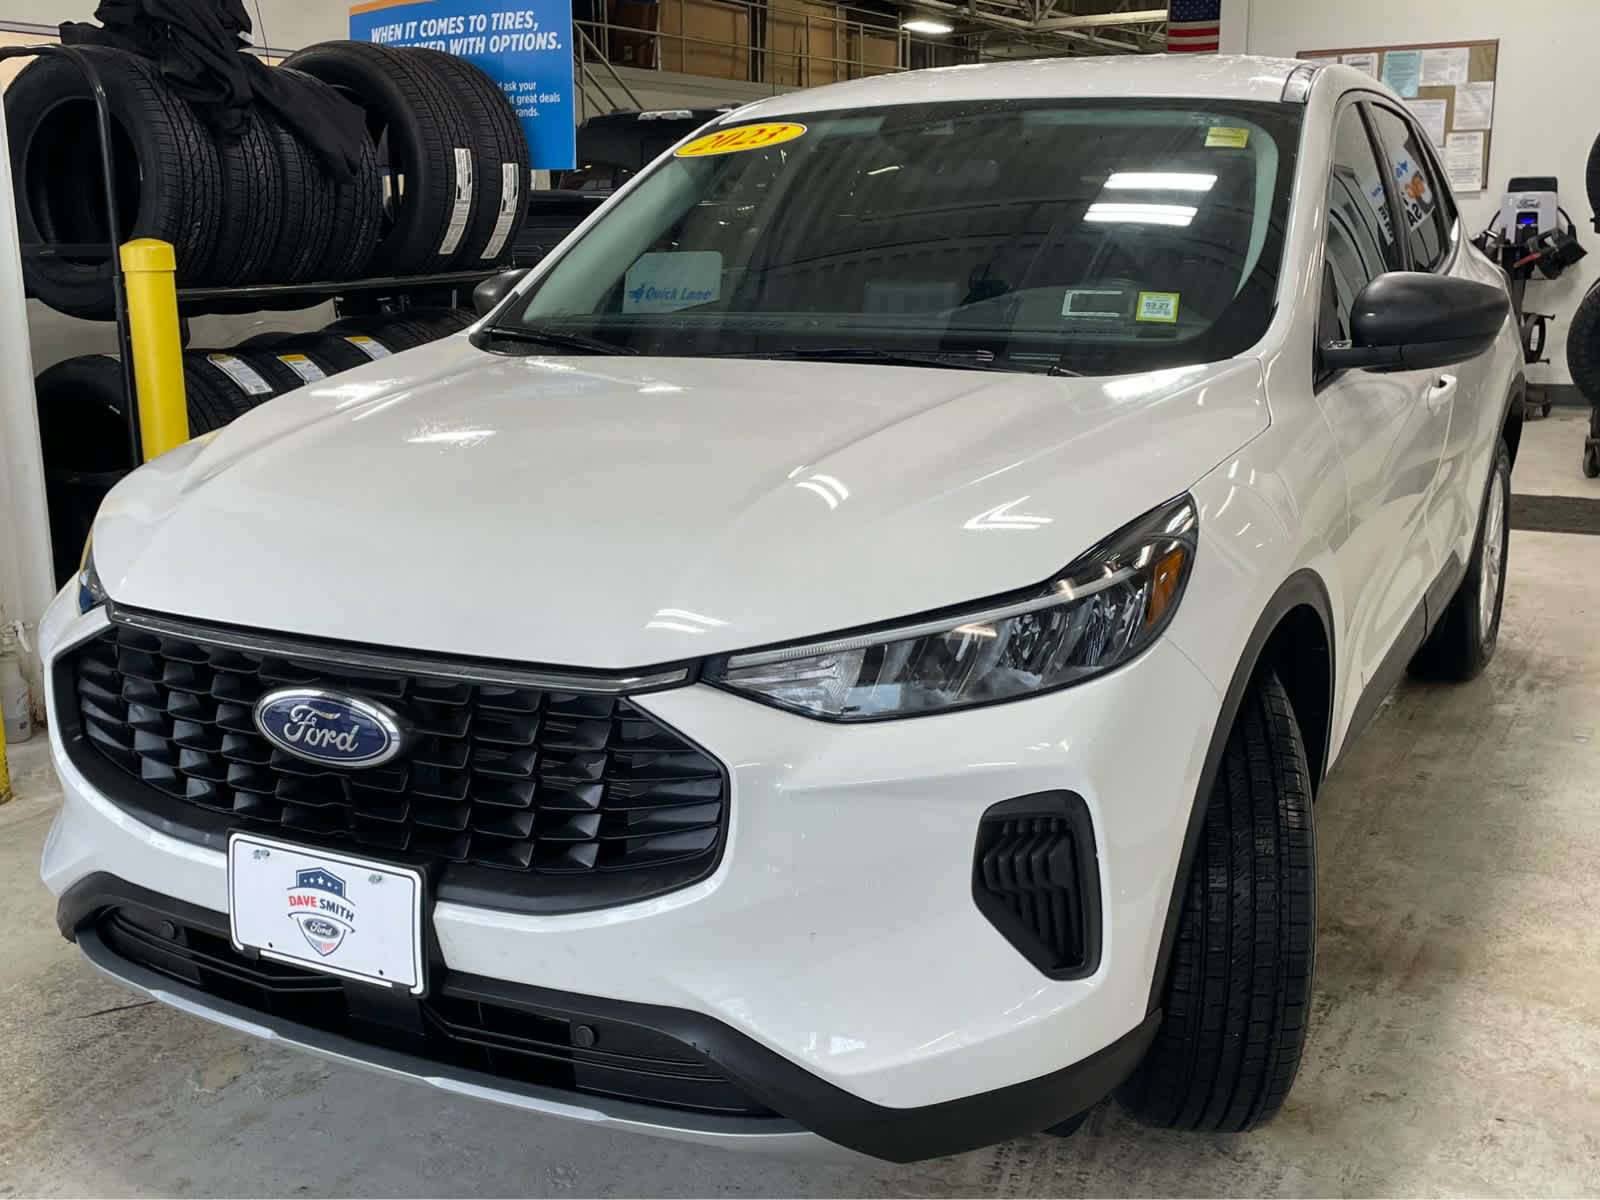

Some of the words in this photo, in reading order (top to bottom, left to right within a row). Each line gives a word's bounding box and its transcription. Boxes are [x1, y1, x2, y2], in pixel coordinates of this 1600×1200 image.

[371, 24, 402, 43] WHEN
[404, 21, 418, 40] IT
[419, 16, 465, 37] COMES
[468, 14, 487, 33] TO
[491, 10, 539, 32] TIRES,
[449, 36, 486, 57] WITH
[489, 31, 562, 52] OPTIONS.
[503, 80, 517, 91] ask
[518, 81, 537, 92] your
[516, 93, 537, 105] great
[539, 92, 561, 103] deals
[688, 127, 789, 152] 2023
[646, 286, 679, 301] Quick
[680, 287, 712, 300] Lane
[283, 705, 360, 752] Ford
[288, 895, 317, 908] DAVE
[319, 898, 354, 922] SMITH
[309, 919, 333, 936] Ford
